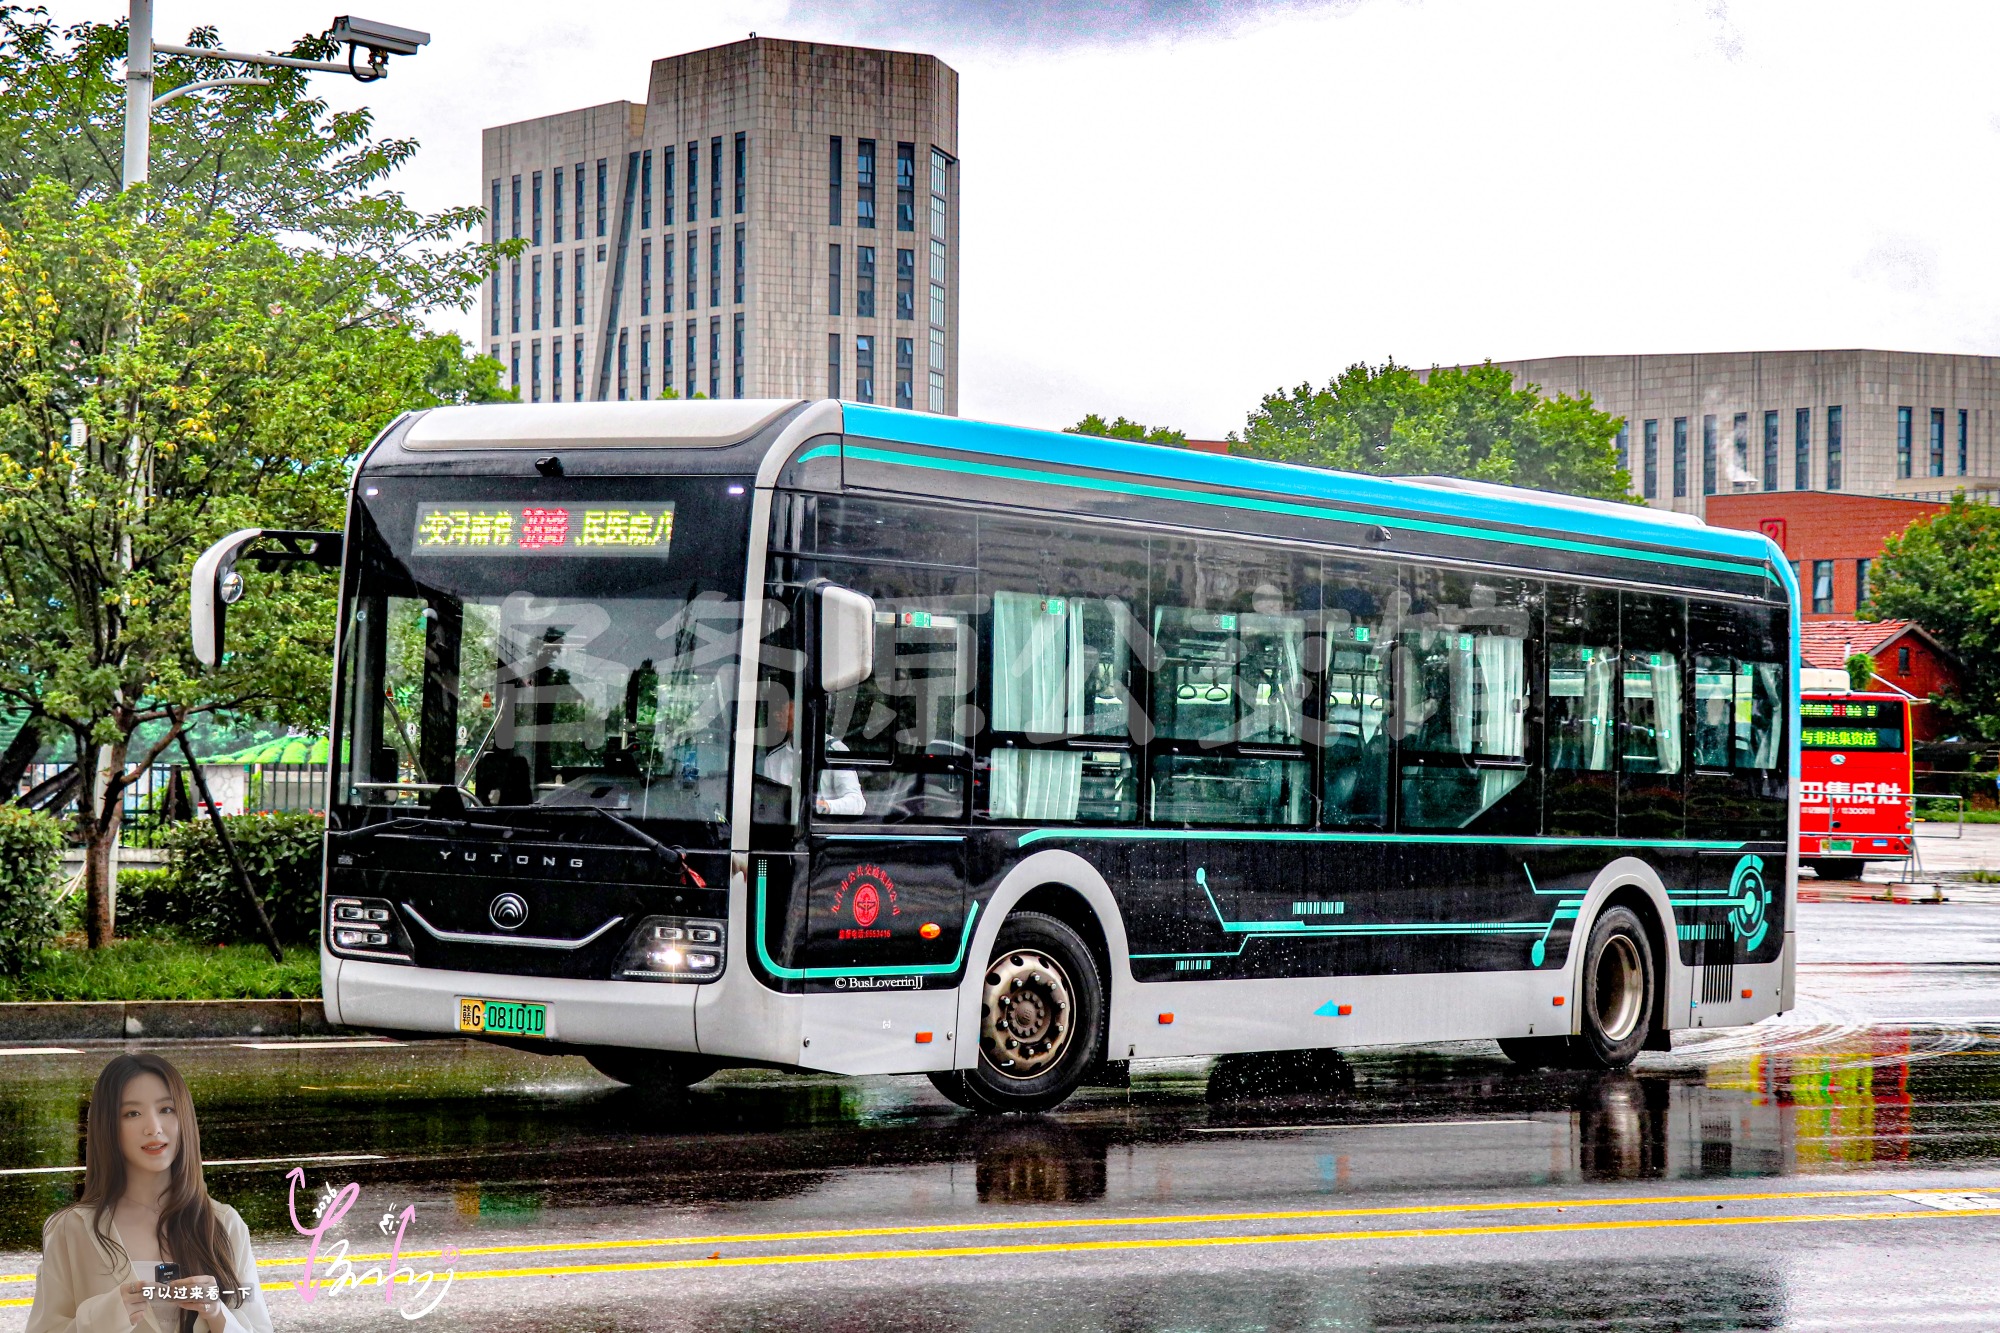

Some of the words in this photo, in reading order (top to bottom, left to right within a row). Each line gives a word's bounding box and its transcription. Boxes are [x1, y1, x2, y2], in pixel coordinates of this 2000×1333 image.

[1800, 730, 1877, 746] 与非法集资活
[439, 851, 583, 868] YUTONG
